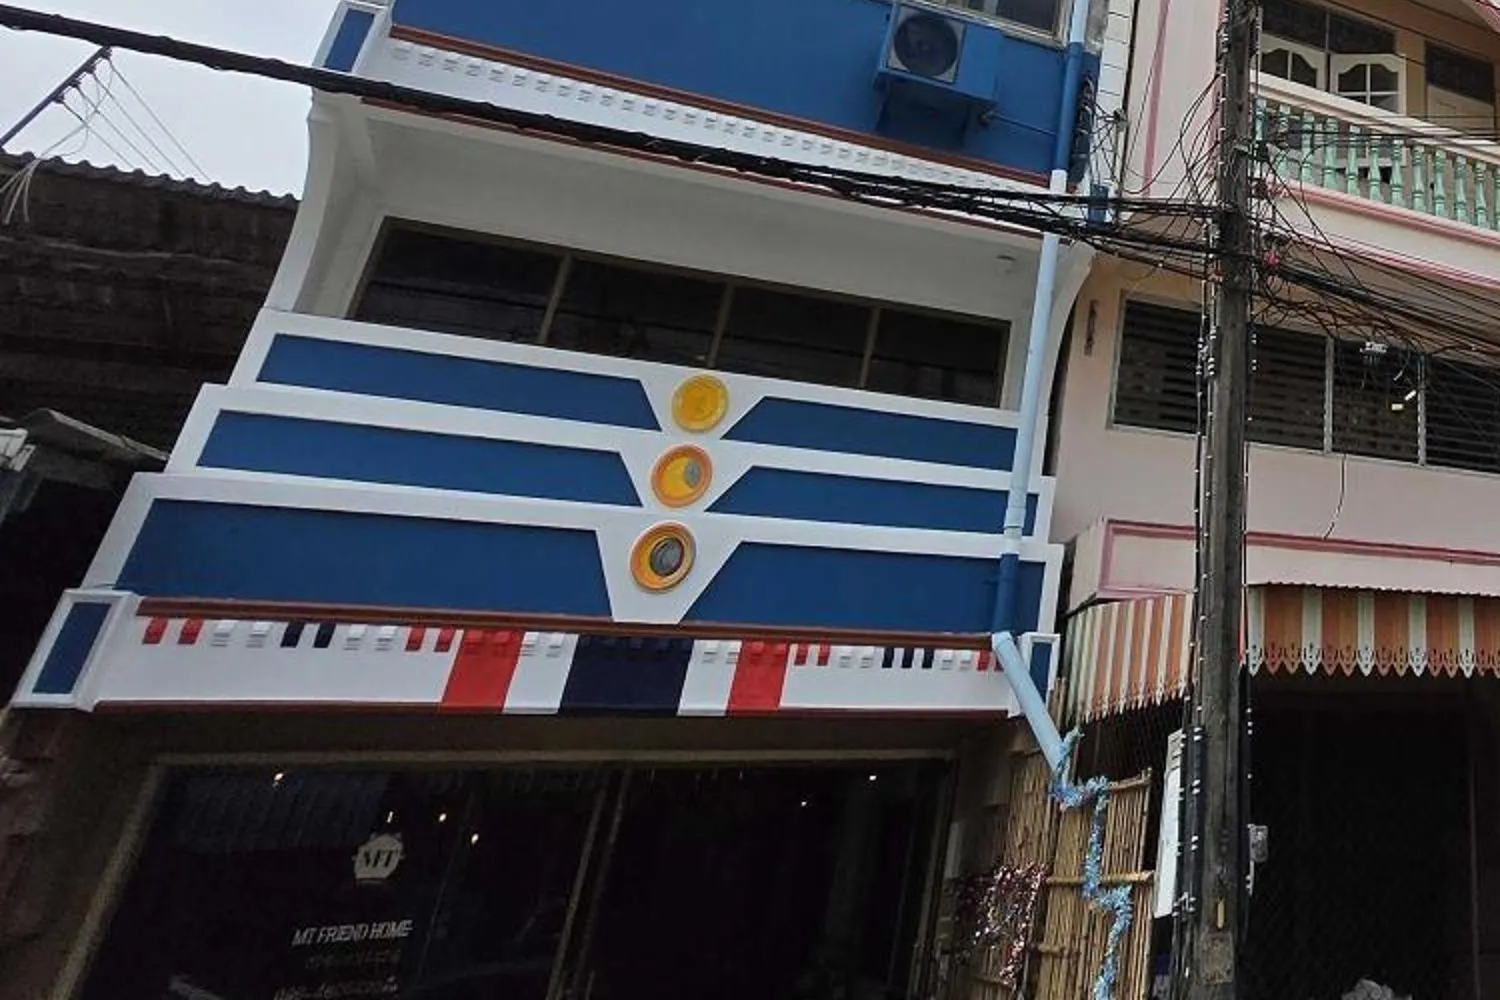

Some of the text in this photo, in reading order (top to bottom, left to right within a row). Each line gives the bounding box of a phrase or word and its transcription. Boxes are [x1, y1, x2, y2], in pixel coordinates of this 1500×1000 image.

[362, 849, 397, 868] MT
[291, 919, 413, 947] MT FRIEND HOME
